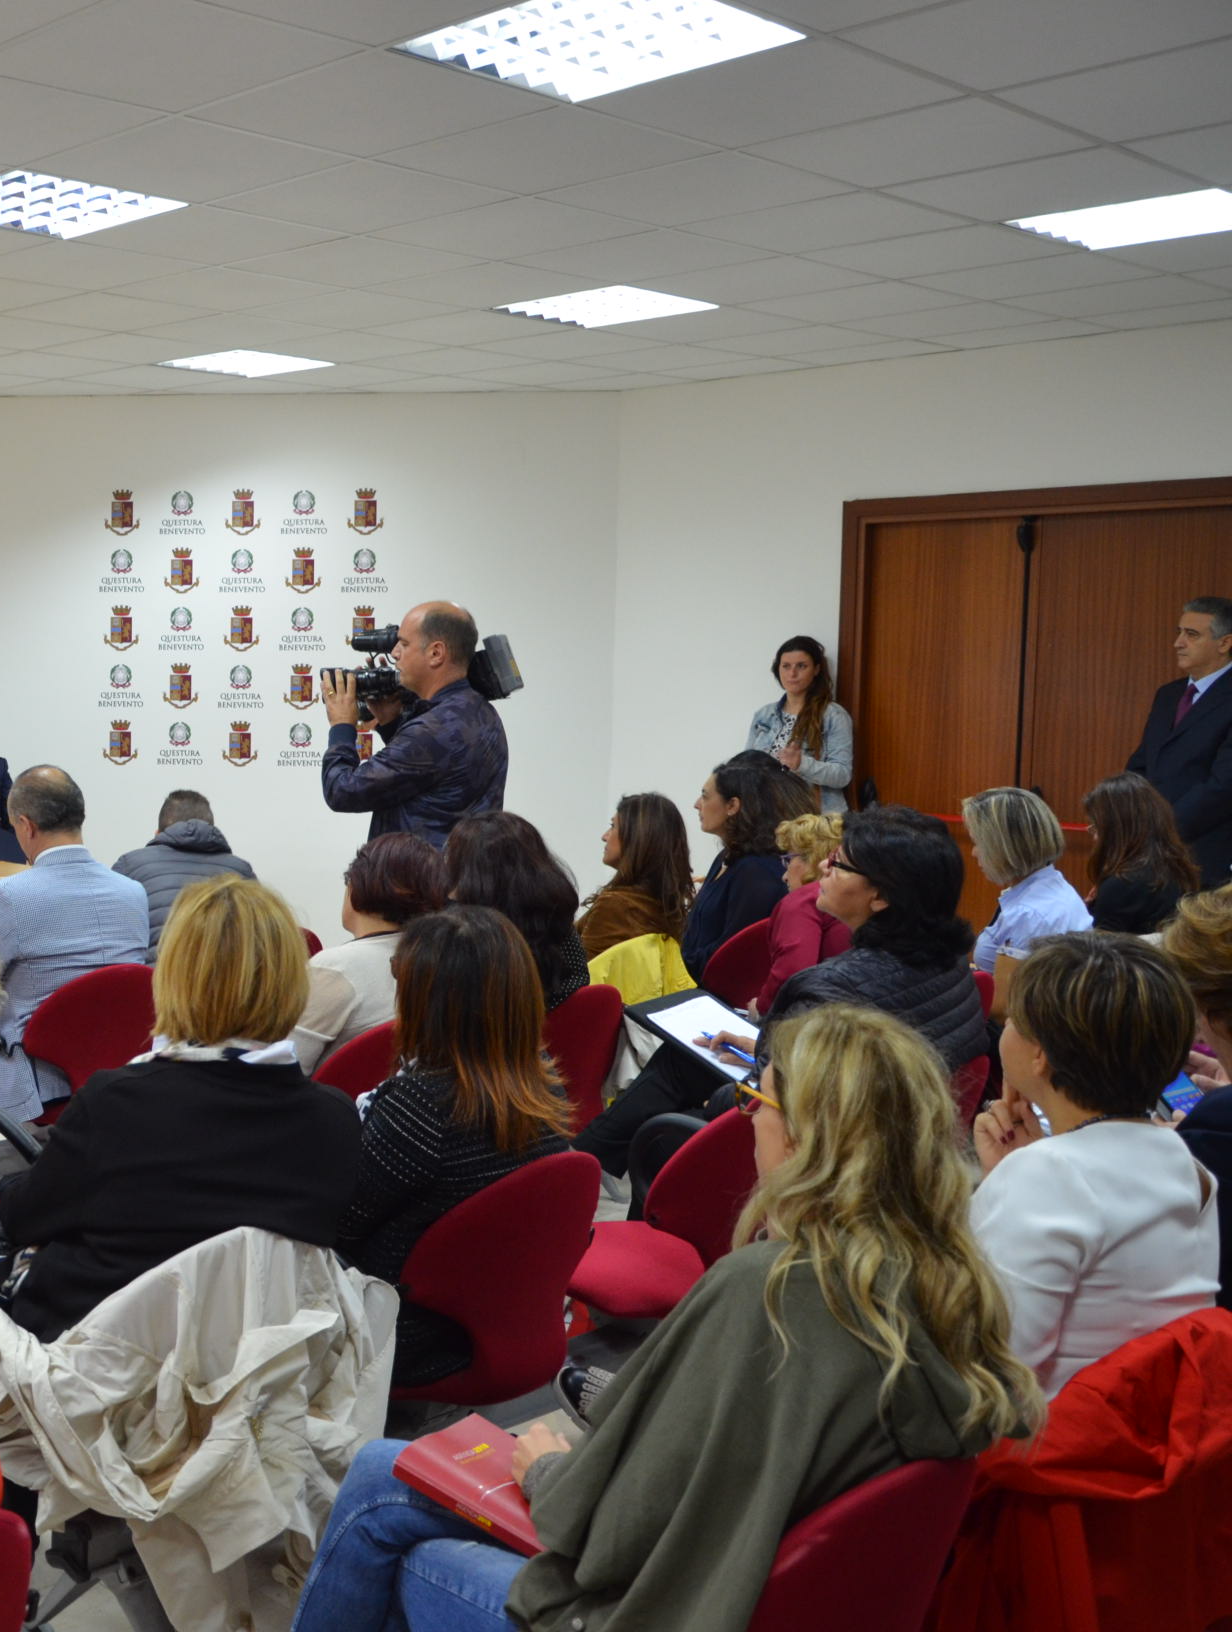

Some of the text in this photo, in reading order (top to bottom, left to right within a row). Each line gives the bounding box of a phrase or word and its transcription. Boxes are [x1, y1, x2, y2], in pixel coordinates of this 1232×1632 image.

[160, 518, 203, 527] QUESTURA
[282, 518, 326, 527] QUESTURA
[158, 527, 206, 536] BENEVENTO
[279, 527, 328, 536] BENEVENTO
[100, 576, 142, 585] QUESTURA
[221, 576, 264, 585] QUESTURA
[342, 576, 386, 585] QUESTURA
[98, 585, 145, 594] BENEVENTO
[218, 585, 266, 594] BENEVENTO
[340, 585, 389, 594] BENEVENTO
[160, 634, 202, 643] QUESTURA
[281, 634, 324, 643] QUESTURA
[157, 643, 205, 652] BENEVENTO
[278, 643, 327, 652] BENEVENTO
[100, 691, 142, 700] QUESTURA
[219, 692, 262, 701] QUESTURA
[97, 700, 145, 709] BENEVENTO
[217, 701, 265, 710] BENEVENTO
[159, 749, 201, 758] QUESTURA
[279, 750, 322, 759] QUESTURA
[156, 758, 204, 767] BENEVENTO
